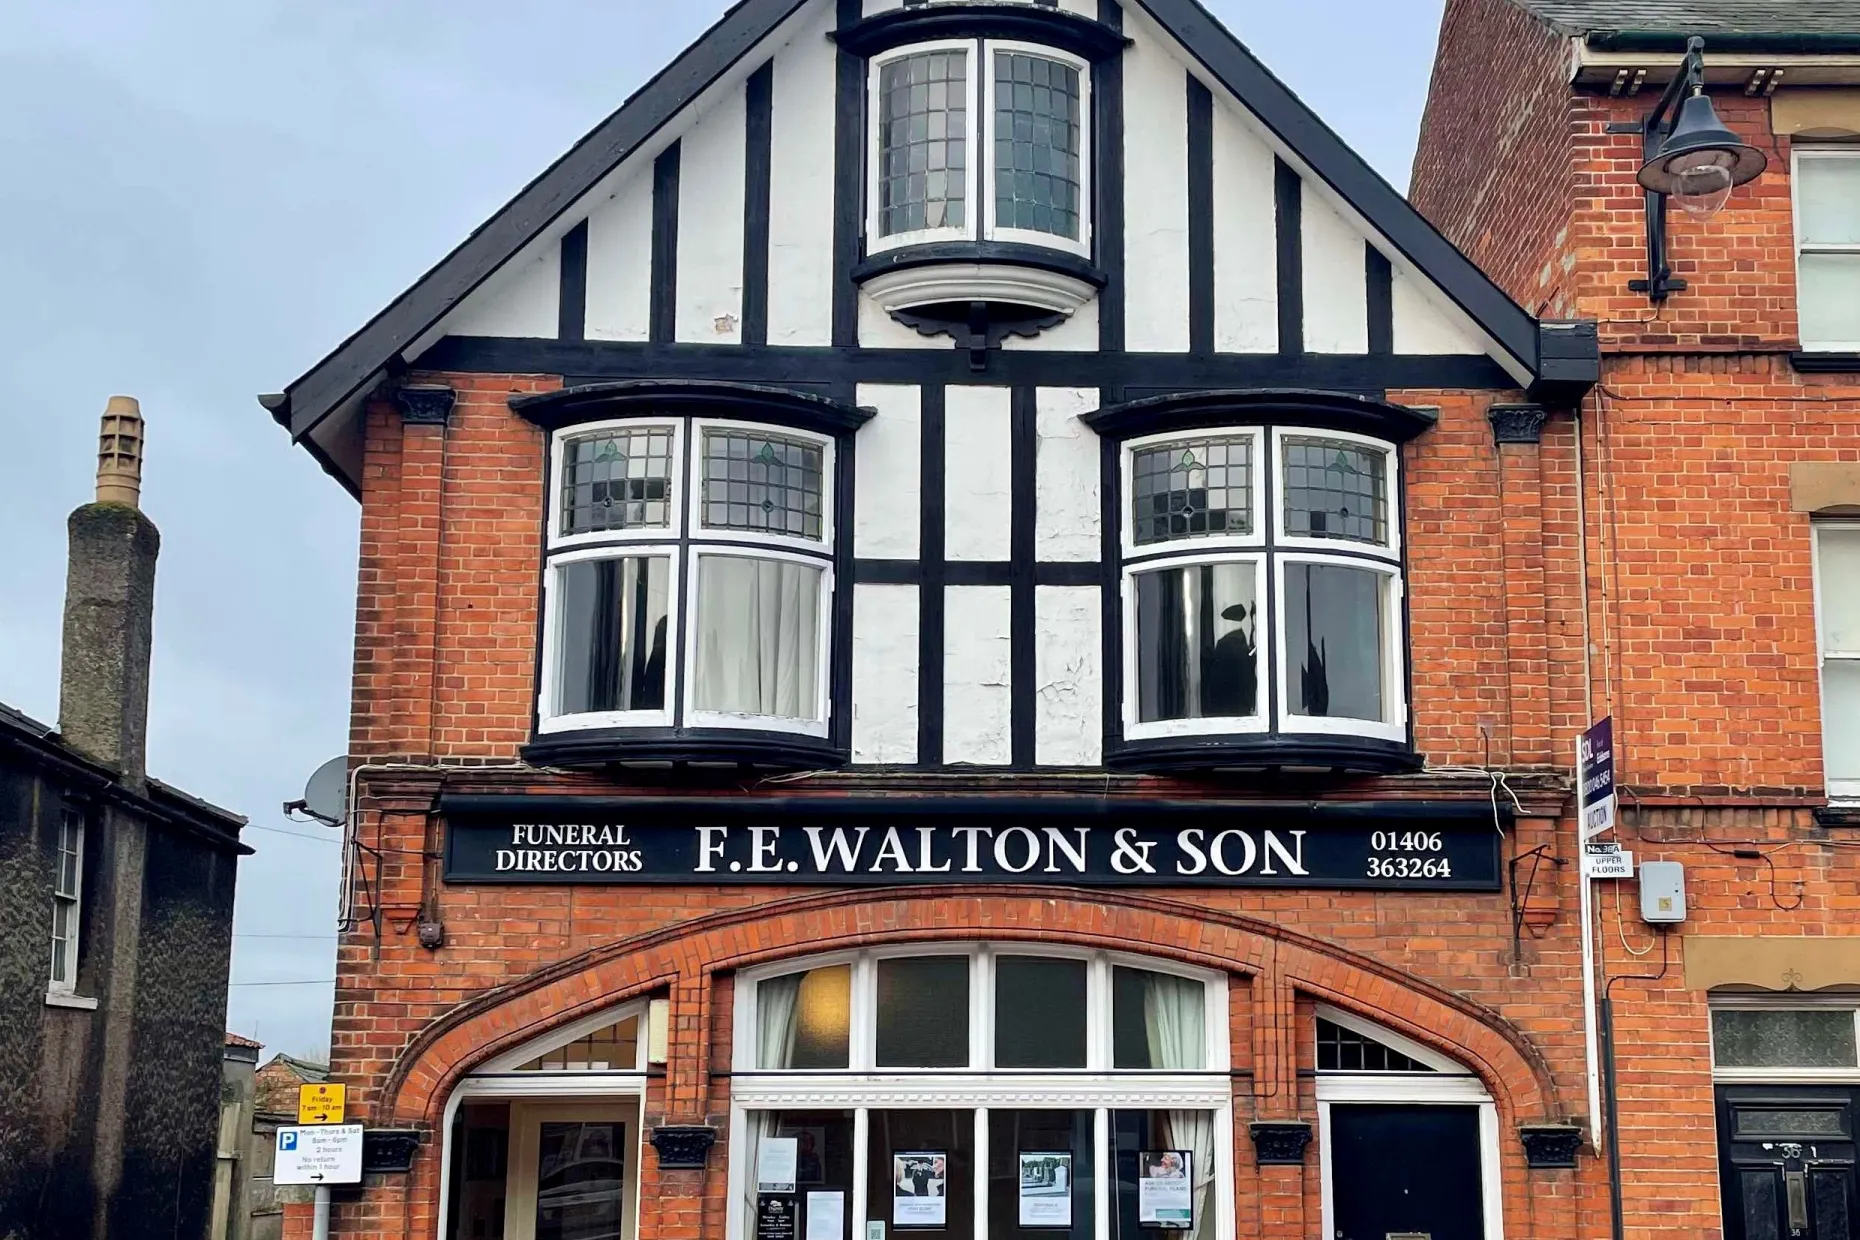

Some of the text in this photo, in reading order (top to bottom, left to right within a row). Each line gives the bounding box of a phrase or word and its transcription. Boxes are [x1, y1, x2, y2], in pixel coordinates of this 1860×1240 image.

[512, 825, 630, 845] FUNERAL
[1371, 831, 1442, 852] 01406
[496, 849, 643, 872] DIRECTORS
[1111, 828, 1157, 874] &
[1177, 829, 1309, 875] SON
[1367, 857, 1451, 878] 363264
[282, 1133, 295, 1149] P
